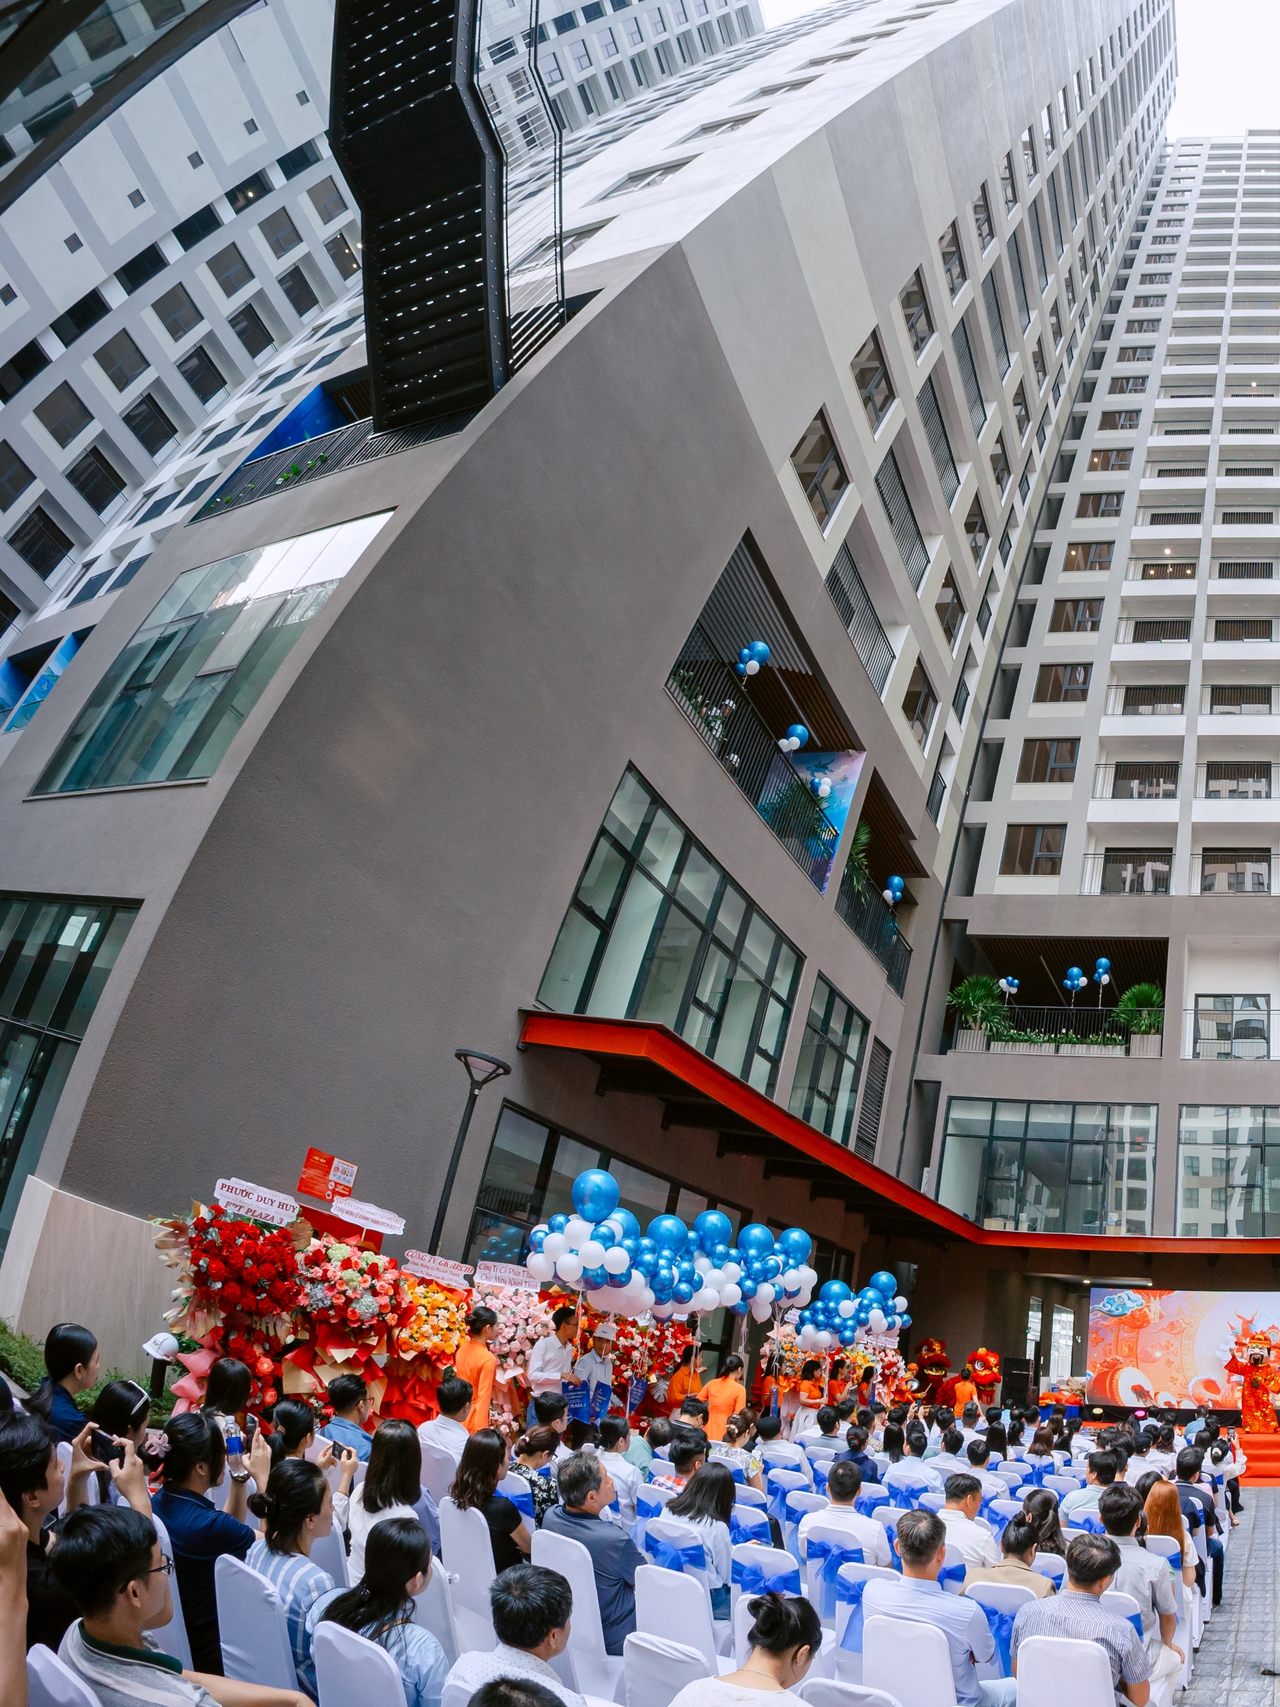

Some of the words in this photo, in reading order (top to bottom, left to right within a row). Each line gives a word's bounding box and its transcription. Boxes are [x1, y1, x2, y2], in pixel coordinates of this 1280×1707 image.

[220, 1183, 254, 1200] PHƯỚC
[256, 1195, 276, 1206] DUY
[277, 1202, 298, 1213] HUY
[245, 1208, 275, 1223] PLAZA
[277, 1217, 284, 1225] 3
